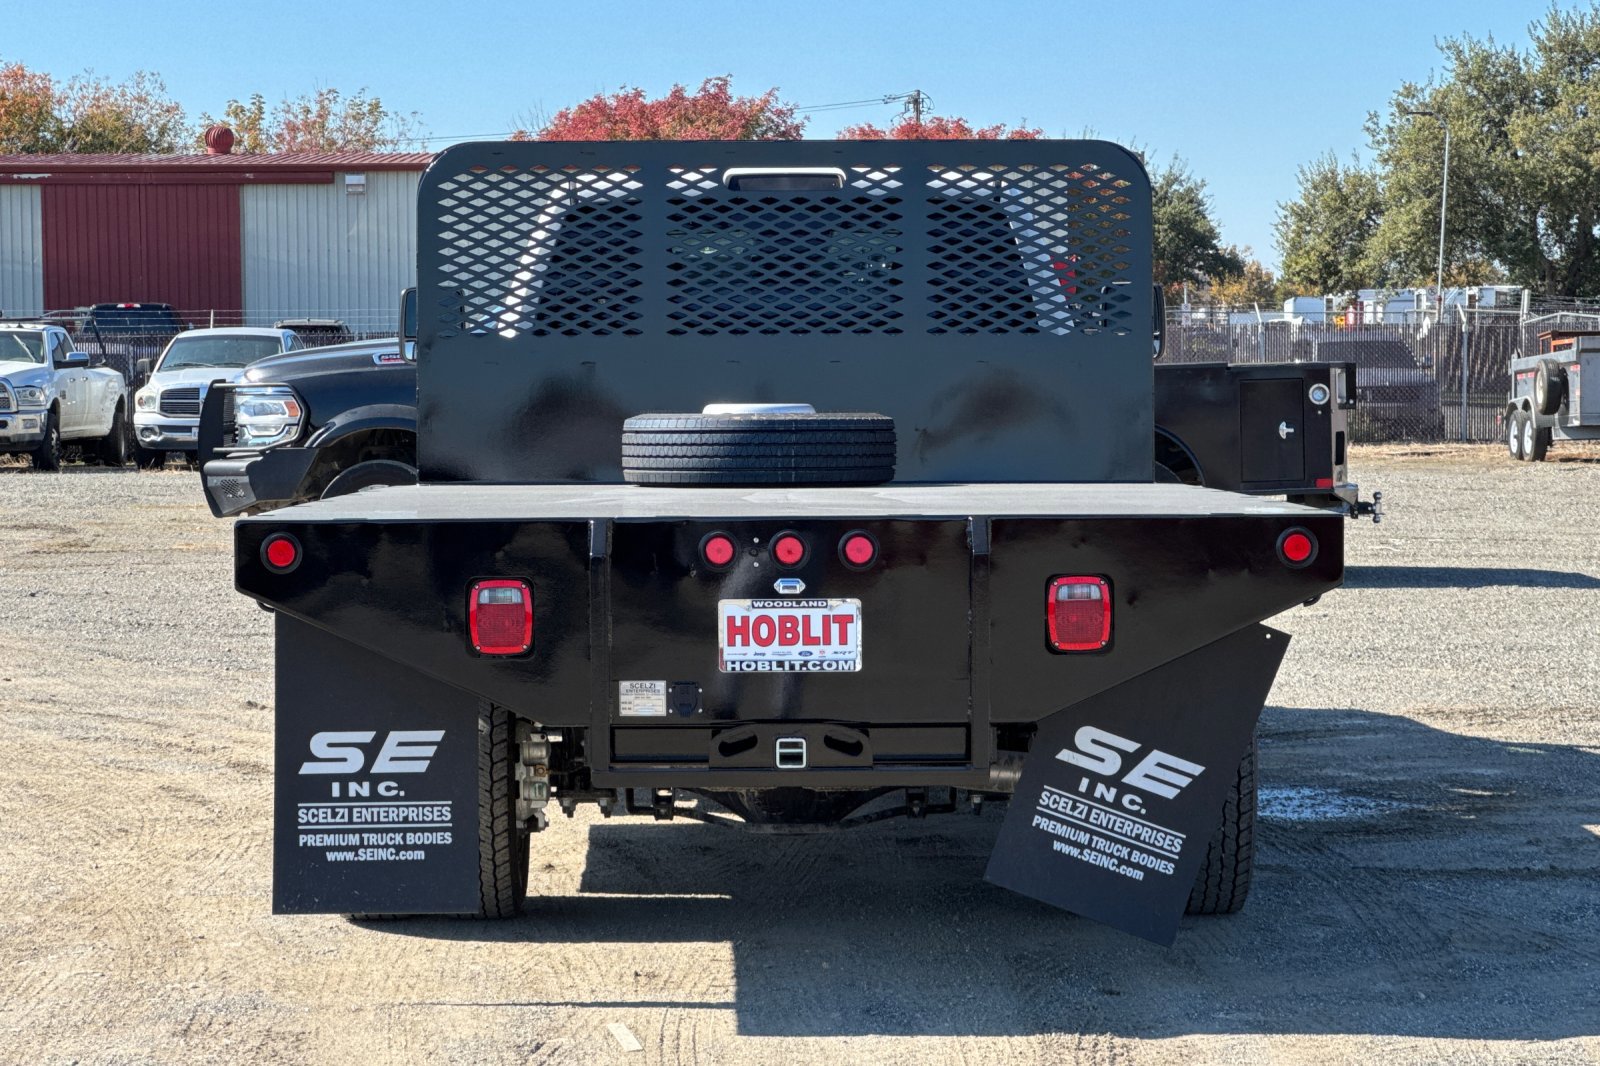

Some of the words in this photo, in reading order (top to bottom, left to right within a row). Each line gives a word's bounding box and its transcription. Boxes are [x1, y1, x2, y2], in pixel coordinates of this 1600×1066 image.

[752, 600, 827, 608] WOODLAND
[726, 614, 854, 647] HOBLIT
[726, 660, 855, 671] HOBLIT.COM
[298, 730, 446, 774] SE
[1055, 725, 1206, 800] SE
[331, 781, 405, 797] INC.
[1078, 777, 1147, 815] INC.
[298, 808, 349, 823] SCELZI
[352, 806, 452, 822] ENTERPRISES
[1039, 790, 1089, 820] SCELZI
[1089, 808, 1183, 853] ENTERPRISES
[299, 833, 360, 847] PREMIUM
[362, 832, 404, 846] TRUCK
[406, 832, 452, 845] BODIES
[326, 848, 425, 862] www.SEINC.com
[1032, 815, 1091, 847] PREMIUM
[1091, 835, 1133, 860] TRUCK
[1130, 850, 1175, 875] BODIES
[1053, 840, 1144, 881] www.SEINC.com
